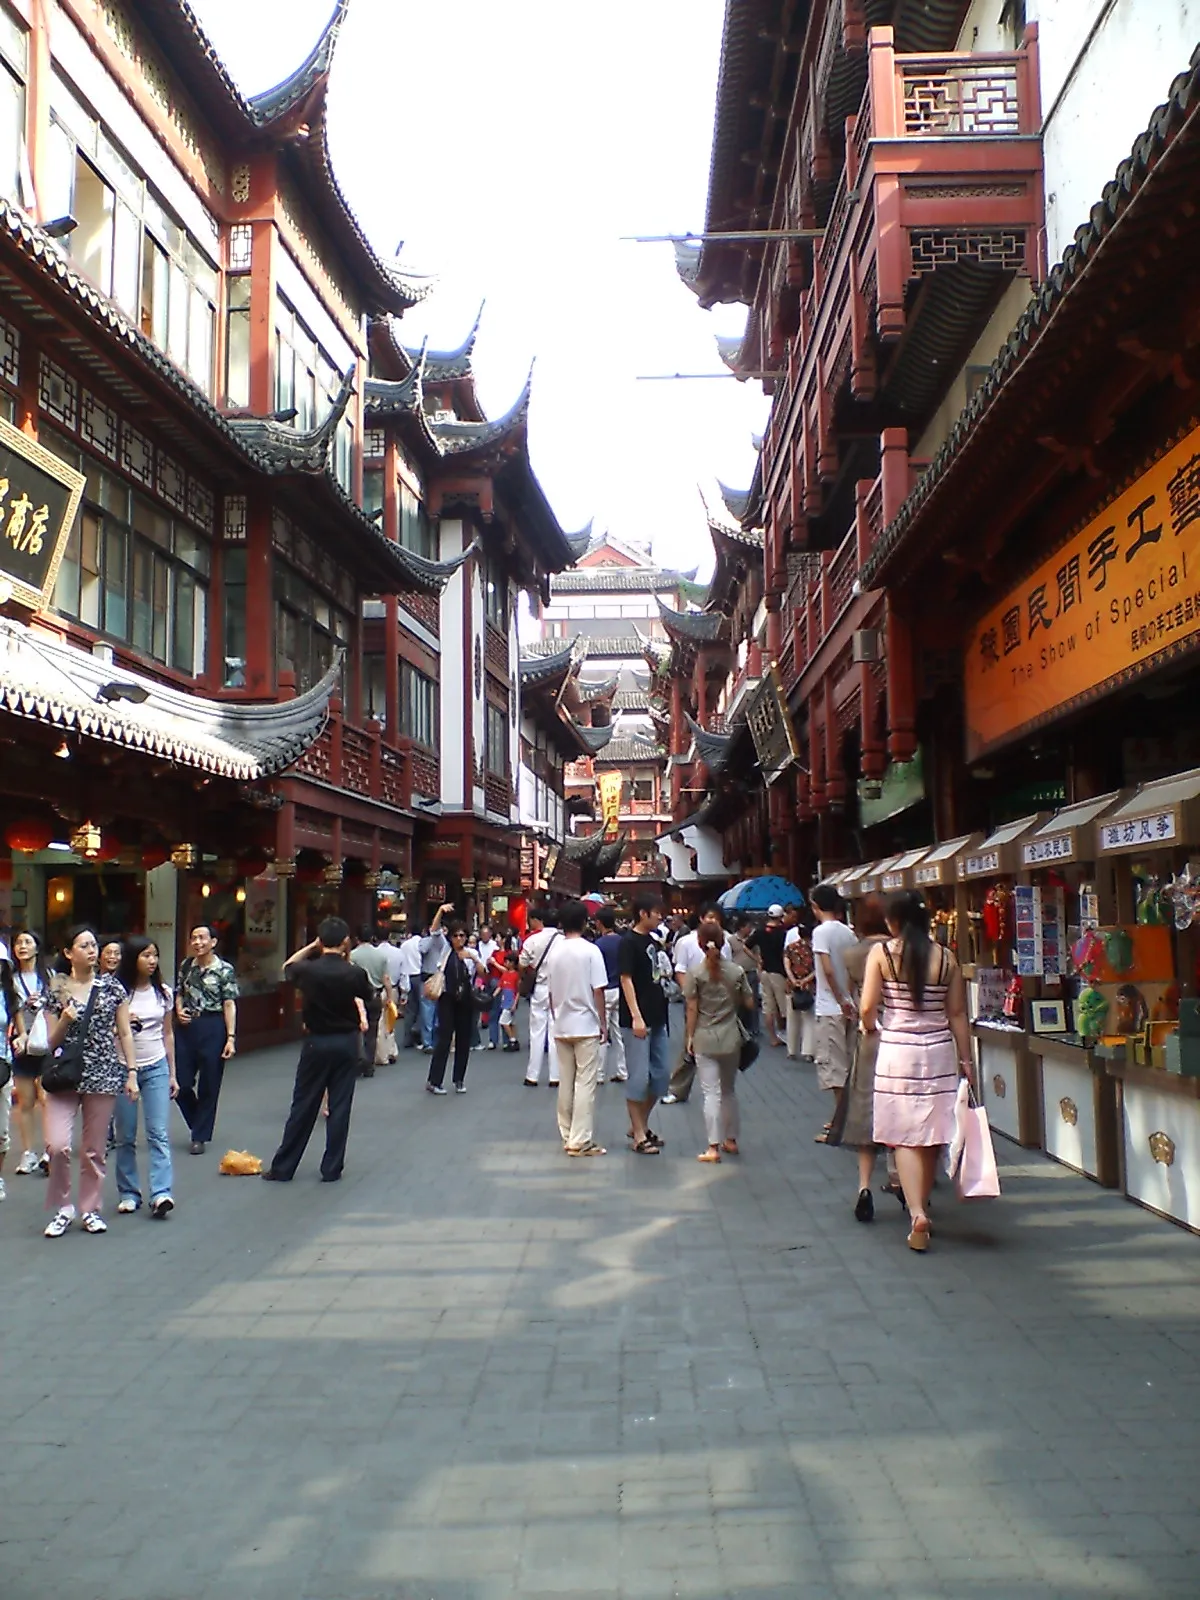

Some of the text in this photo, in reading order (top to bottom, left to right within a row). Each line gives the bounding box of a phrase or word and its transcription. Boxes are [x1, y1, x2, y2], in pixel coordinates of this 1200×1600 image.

[1041, 631, 1077, 671] Show
[1085, 612, 1102, 642] of
[1110, 551, 1187, 624] Special
[1108, 814, 1170, 844] 潍坊风筝
